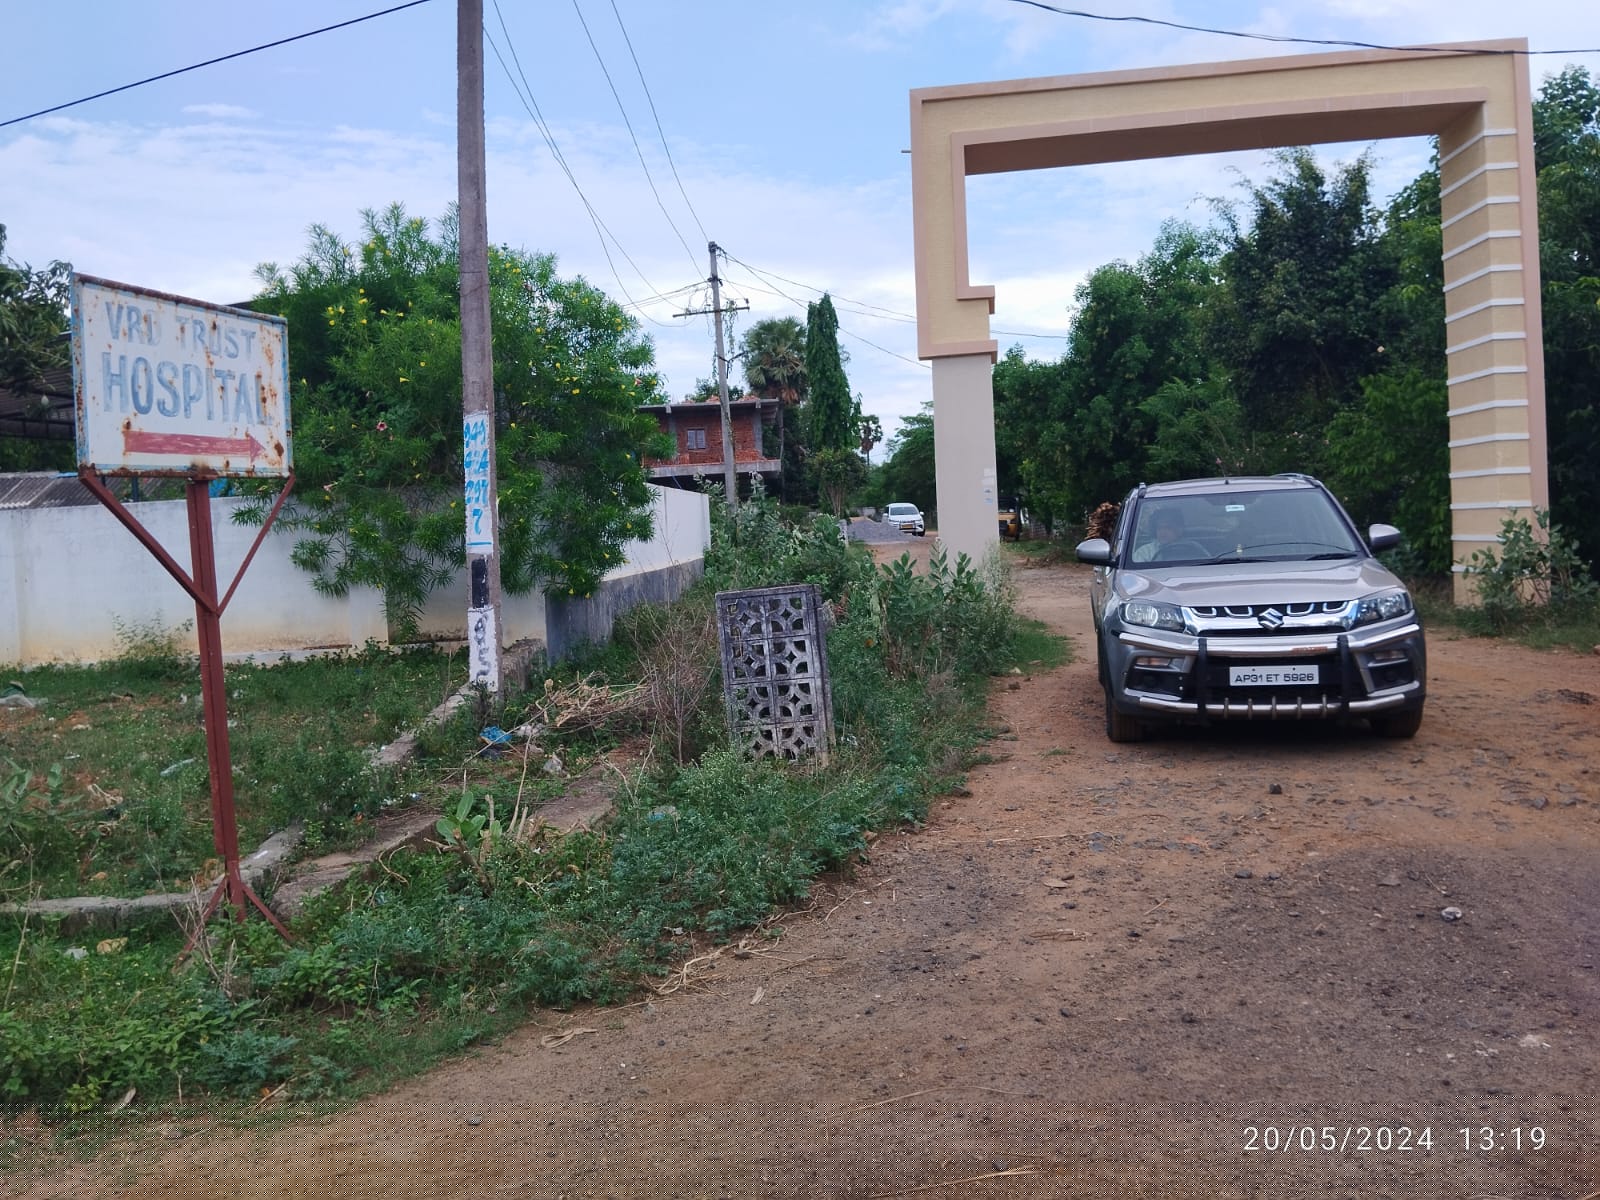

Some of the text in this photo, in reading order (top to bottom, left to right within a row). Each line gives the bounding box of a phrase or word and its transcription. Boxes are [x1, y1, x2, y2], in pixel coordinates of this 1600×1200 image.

[175, 315, 257, 362] TRUST
[102, 352, 272, 425] HOSPITAL
[1234, 673, 1263, 683] AP31
[1266, 673, 1280, 682] ET
